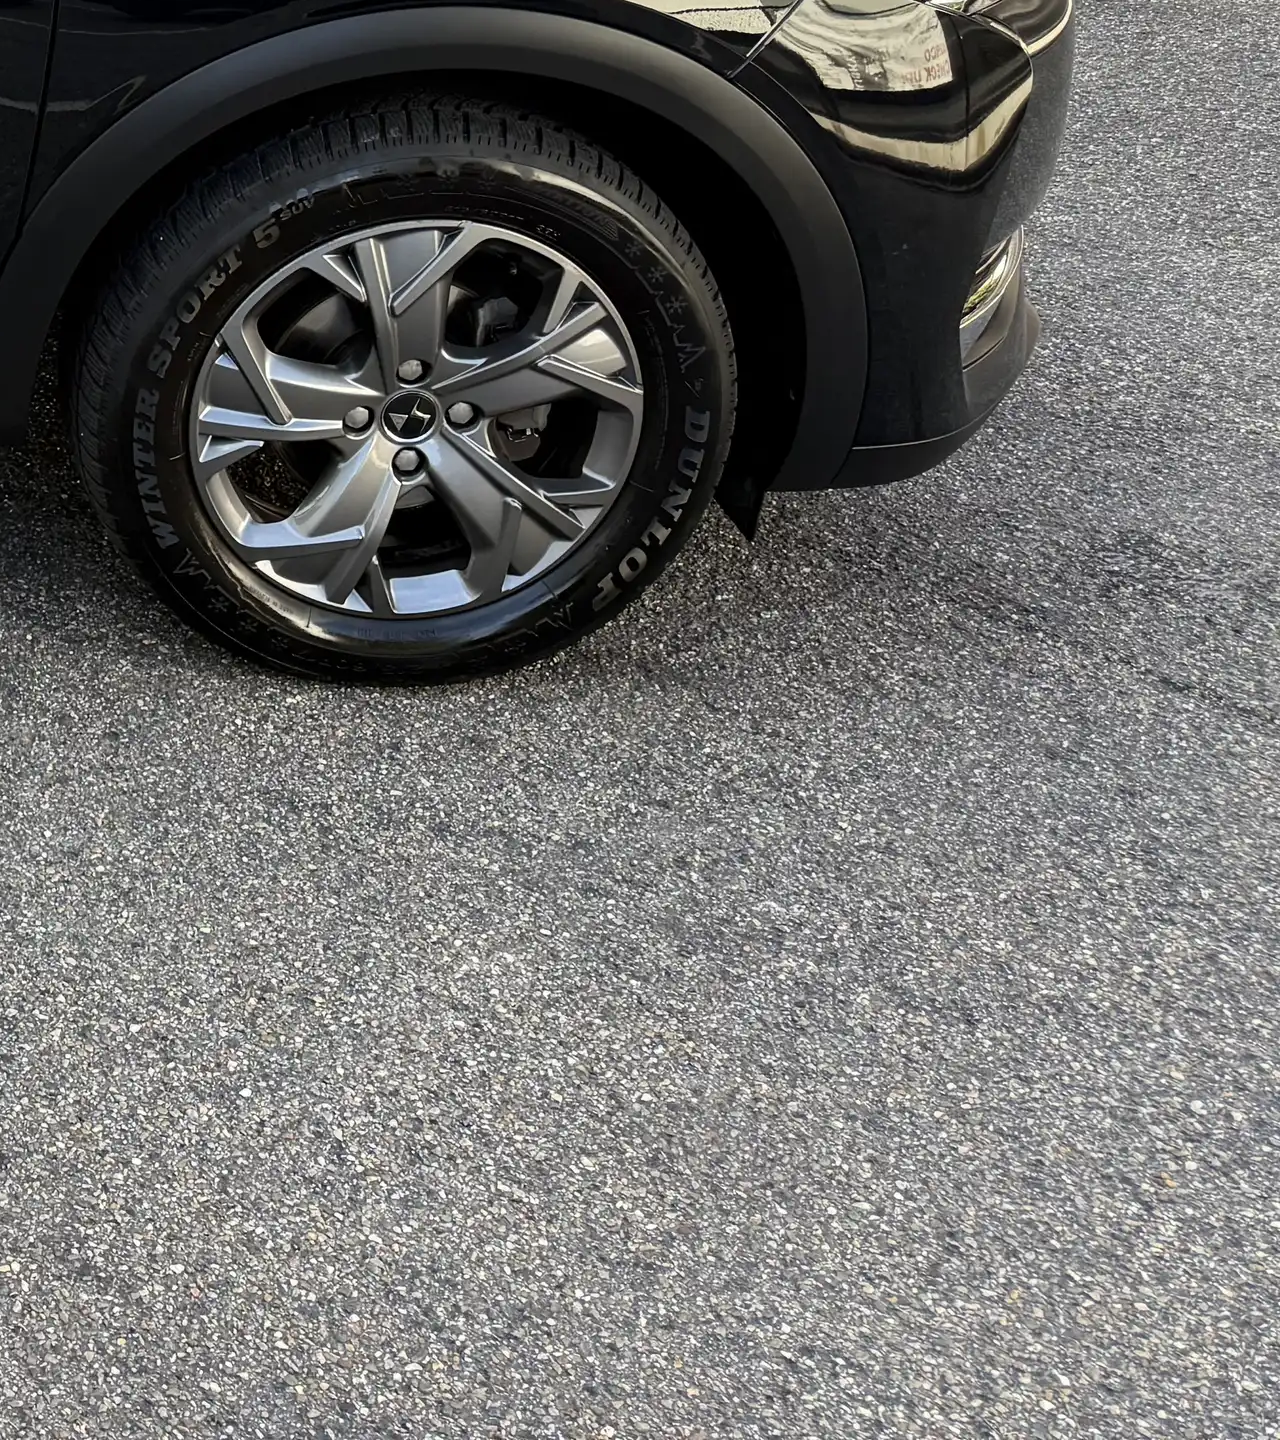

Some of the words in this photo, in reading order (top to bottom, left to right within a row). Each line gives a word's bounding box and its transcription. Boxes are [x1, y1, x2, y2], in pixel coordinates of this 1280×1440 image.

[252, 217, 281, 249] 5
[279, 194, 316, 221] SUV
[149, 244, 243, 379] SPORT
[133, 387, 180, 550] WINTER
[592, 405, 711, 611] DUNLOP
